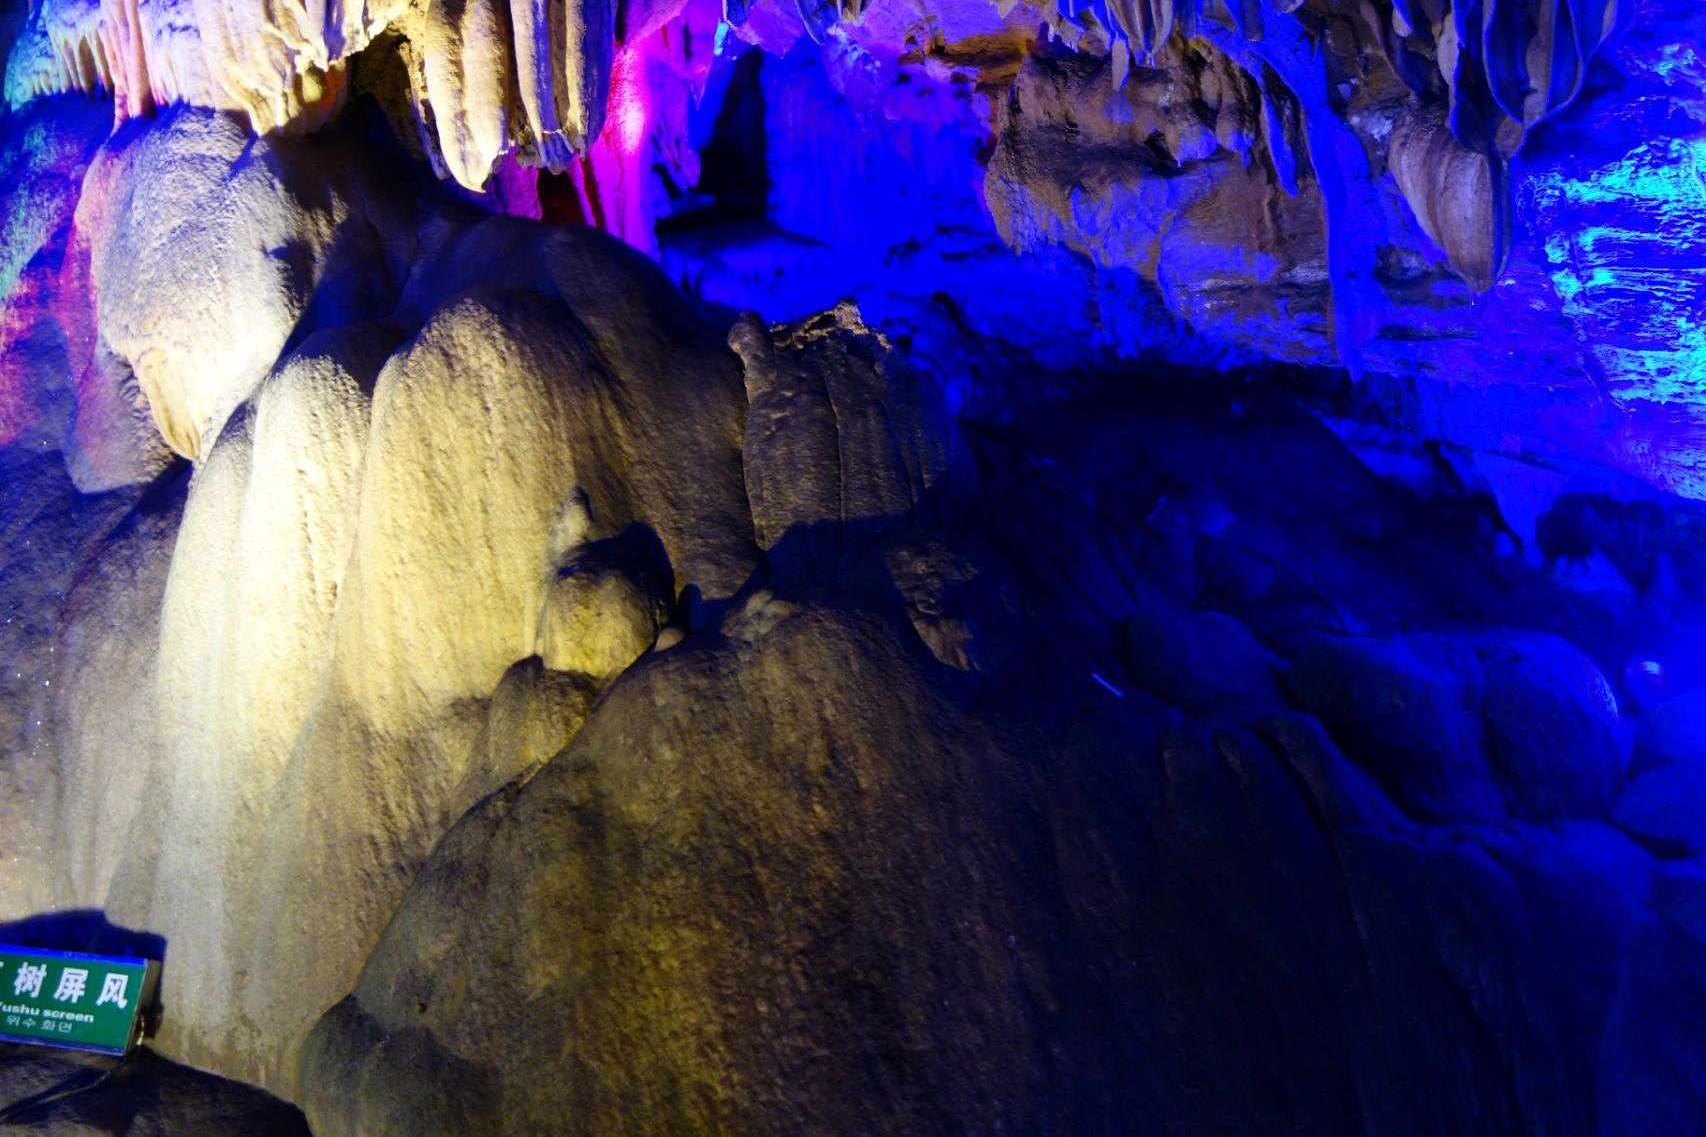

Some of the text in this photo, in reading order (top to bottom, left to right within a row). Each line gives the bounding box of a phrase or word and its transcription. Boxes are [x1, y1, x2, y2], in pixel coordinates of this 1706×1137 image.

[0, 961, 129, 1009] 树屏风
[42, 1009, 95, 1023] screen
